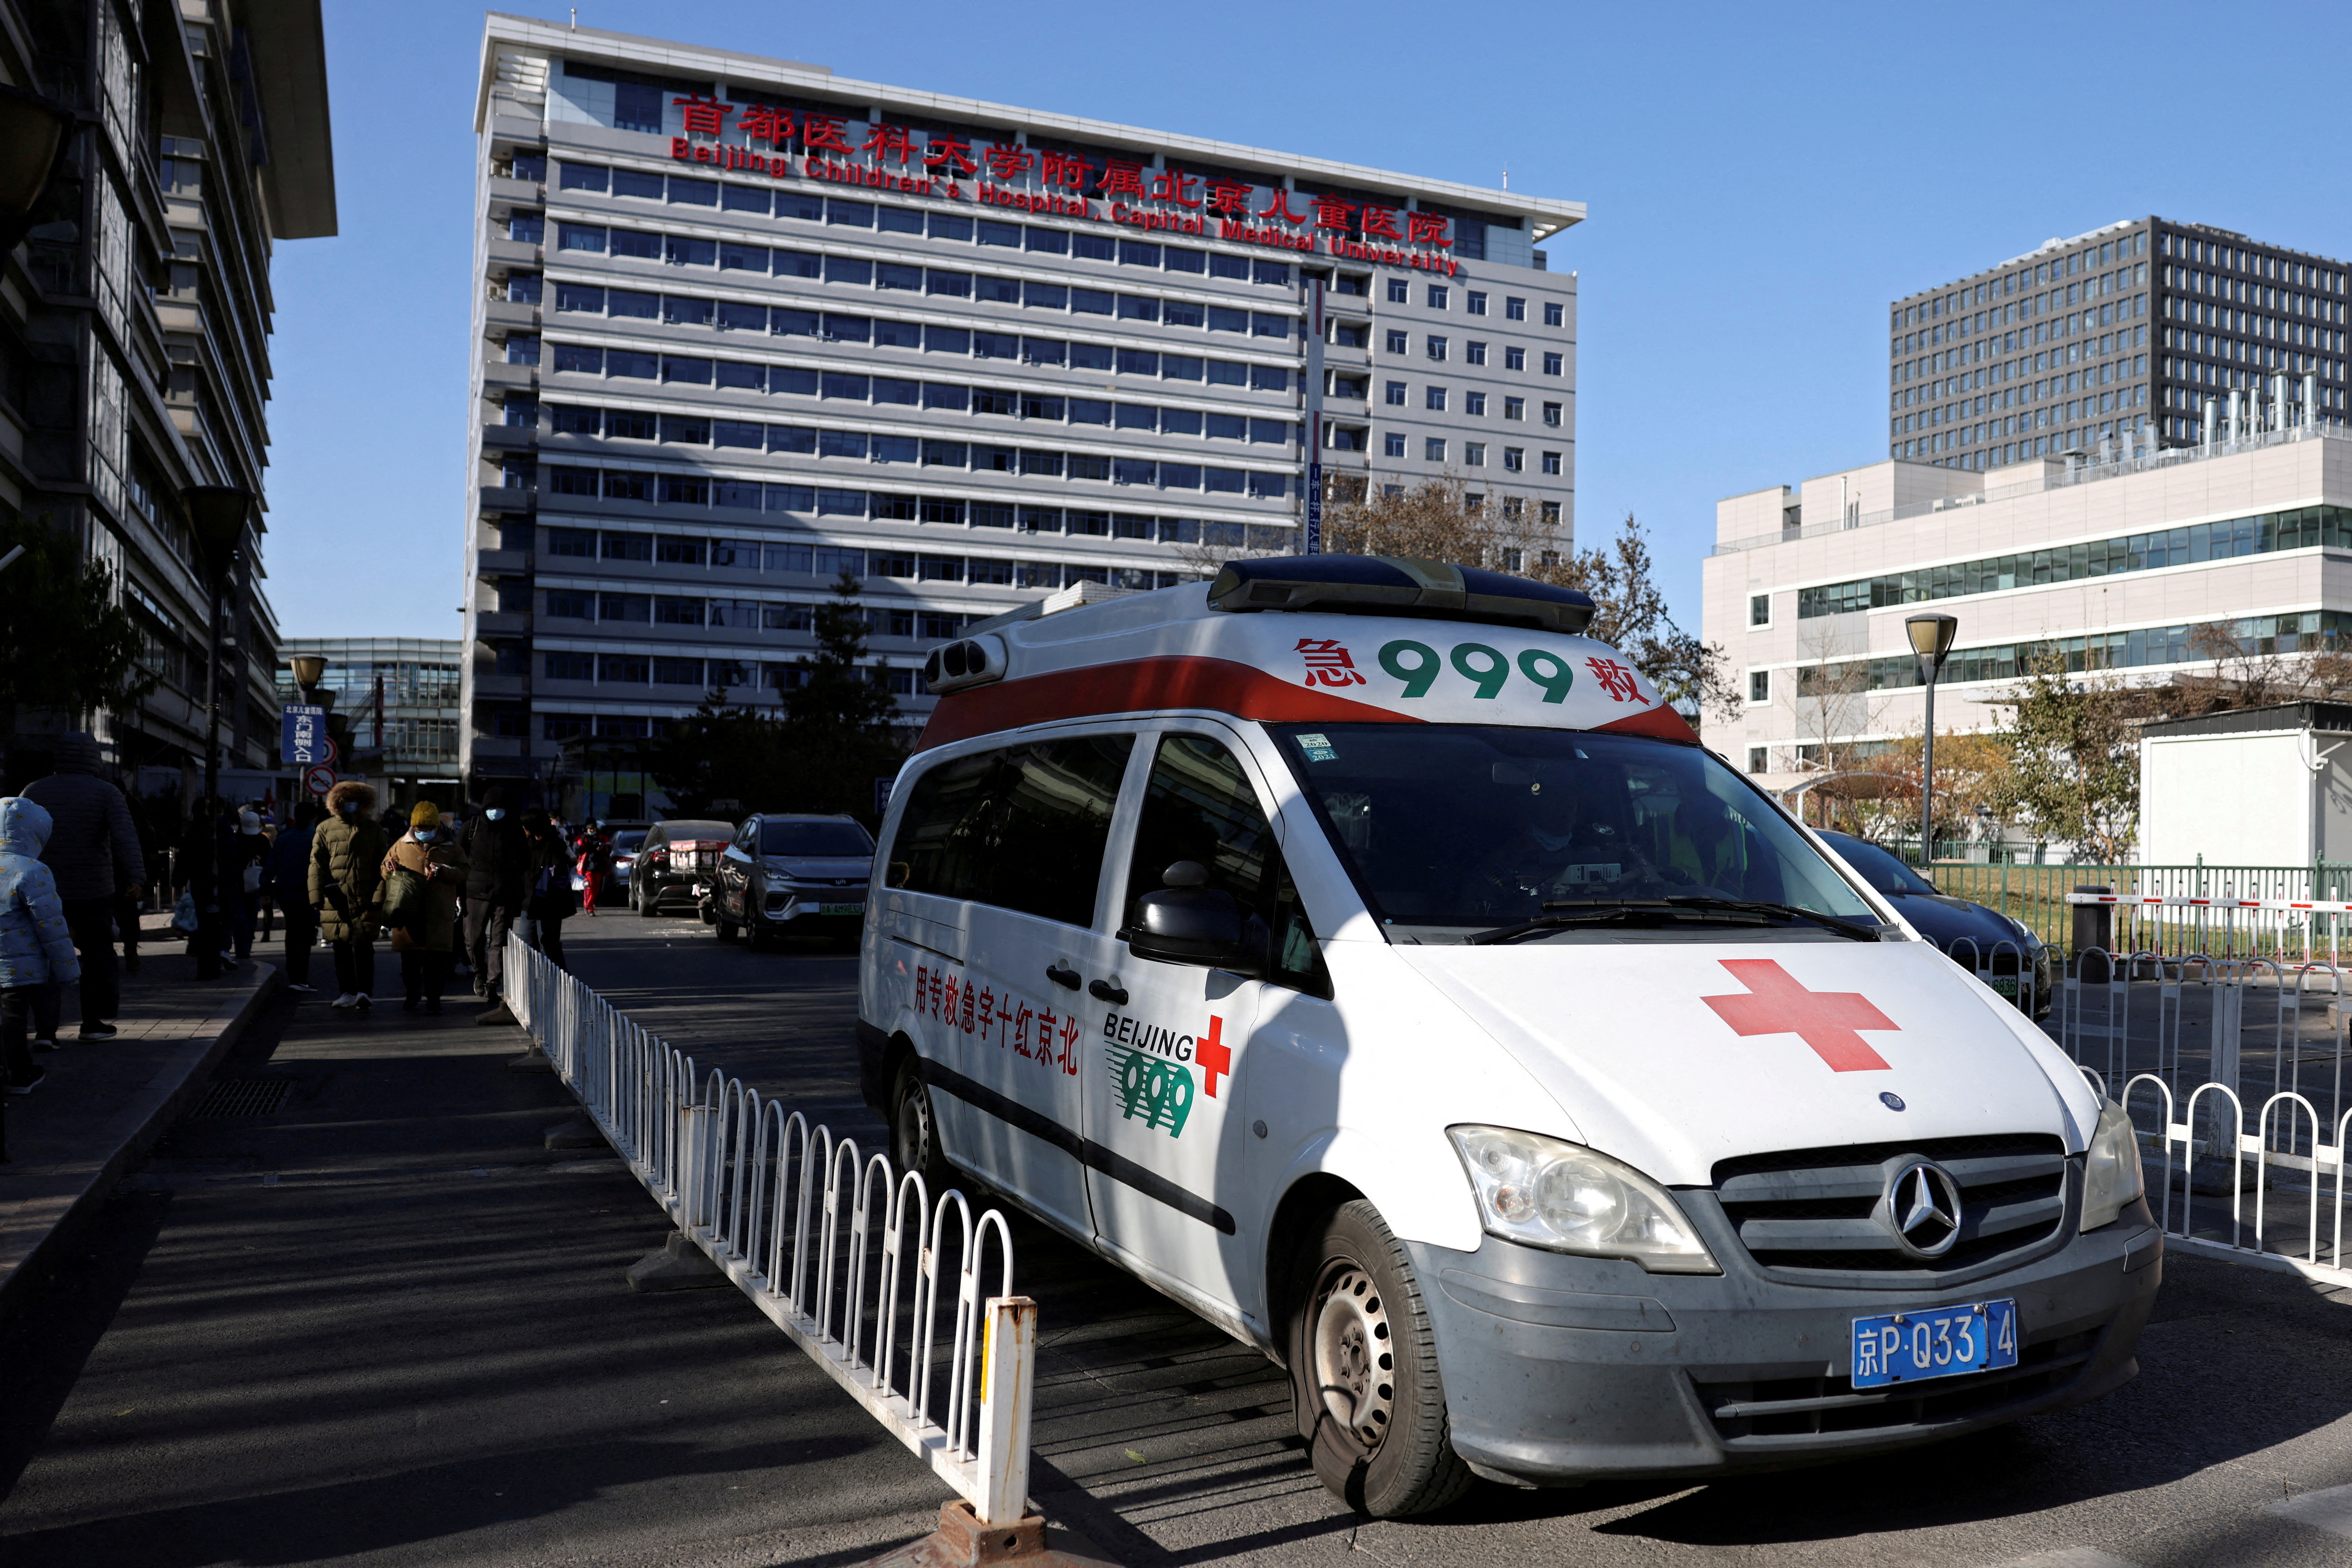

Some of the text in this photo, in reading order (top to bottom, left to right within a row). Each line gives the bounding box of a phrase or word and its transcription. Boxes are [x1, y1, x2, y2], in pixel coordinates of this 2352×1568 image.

[672, 92, 1454, 248] 首都医科大学附属北京儿童医院
[671, 136, 785, 178] Beijing
[804, 156, 960, 198] Children's
[1110, 201, 1203, 235] Capital
[1220, 220, 1314, 251] Medical
[1329, 236, 1458, 277] University
[1378, 639, 1573, 704] 999
[286, 705, 323, 715] 北京儿童医院
[293, 715, 313, 762] 东门南侧入口
[1104, 1013, 1194, 1062] BEIJING
